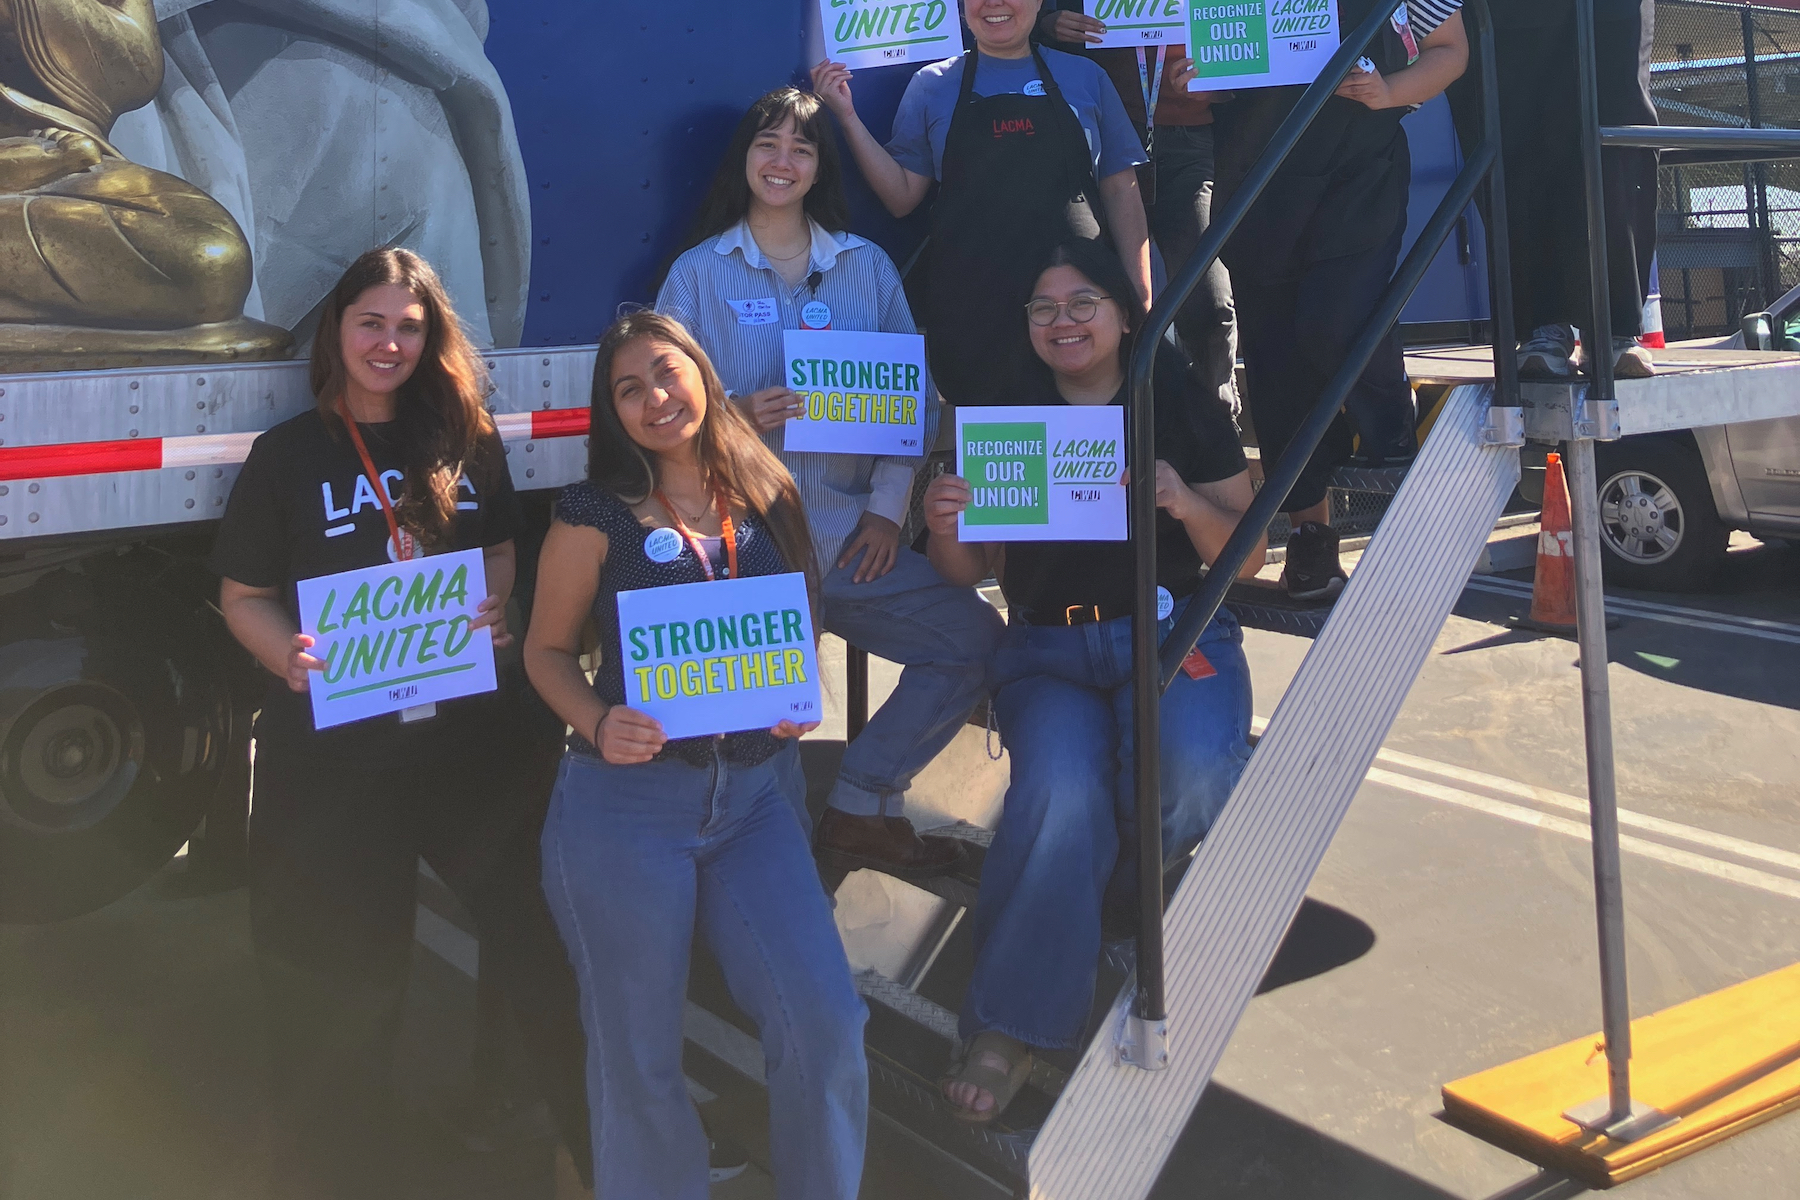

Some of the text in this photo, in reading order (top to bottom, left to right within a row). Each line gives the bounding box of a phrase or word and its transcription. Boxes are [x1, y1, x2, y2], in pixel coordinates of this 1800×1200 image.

[834, 0, 947, 42] UNITED
[1193, 2, 1263, 21] RECOGNIZE
[1210, 21, 1247, 42] OUR
[1272, 13, 1331, 34] UNITED
[1200, 42, 1260, 64] UNION!
[993, 118, 1034, 134] LACMA
[791, 358, 920, 392] STRONGER
[966, 440, 1044, 457] RECOGNIZE
[1053, 439, 1117, 458] LACMA
[985, 461, 1025, 482] OUR
[1053, 460, 1118, 479] UNITED
[322, 469, 477, 522] LACA
[973, 486, 1039, 508] UNION!
[649, 533, 675, 548] LACMA
[652, 541, 678, 555] UNITED
[317, 563, 468, 635] LACMA
[629, 608, 805, 661] STRONGER
[322, 614, 474, 684] UNITED
[634, 648, 808, 703] TOGETHER
